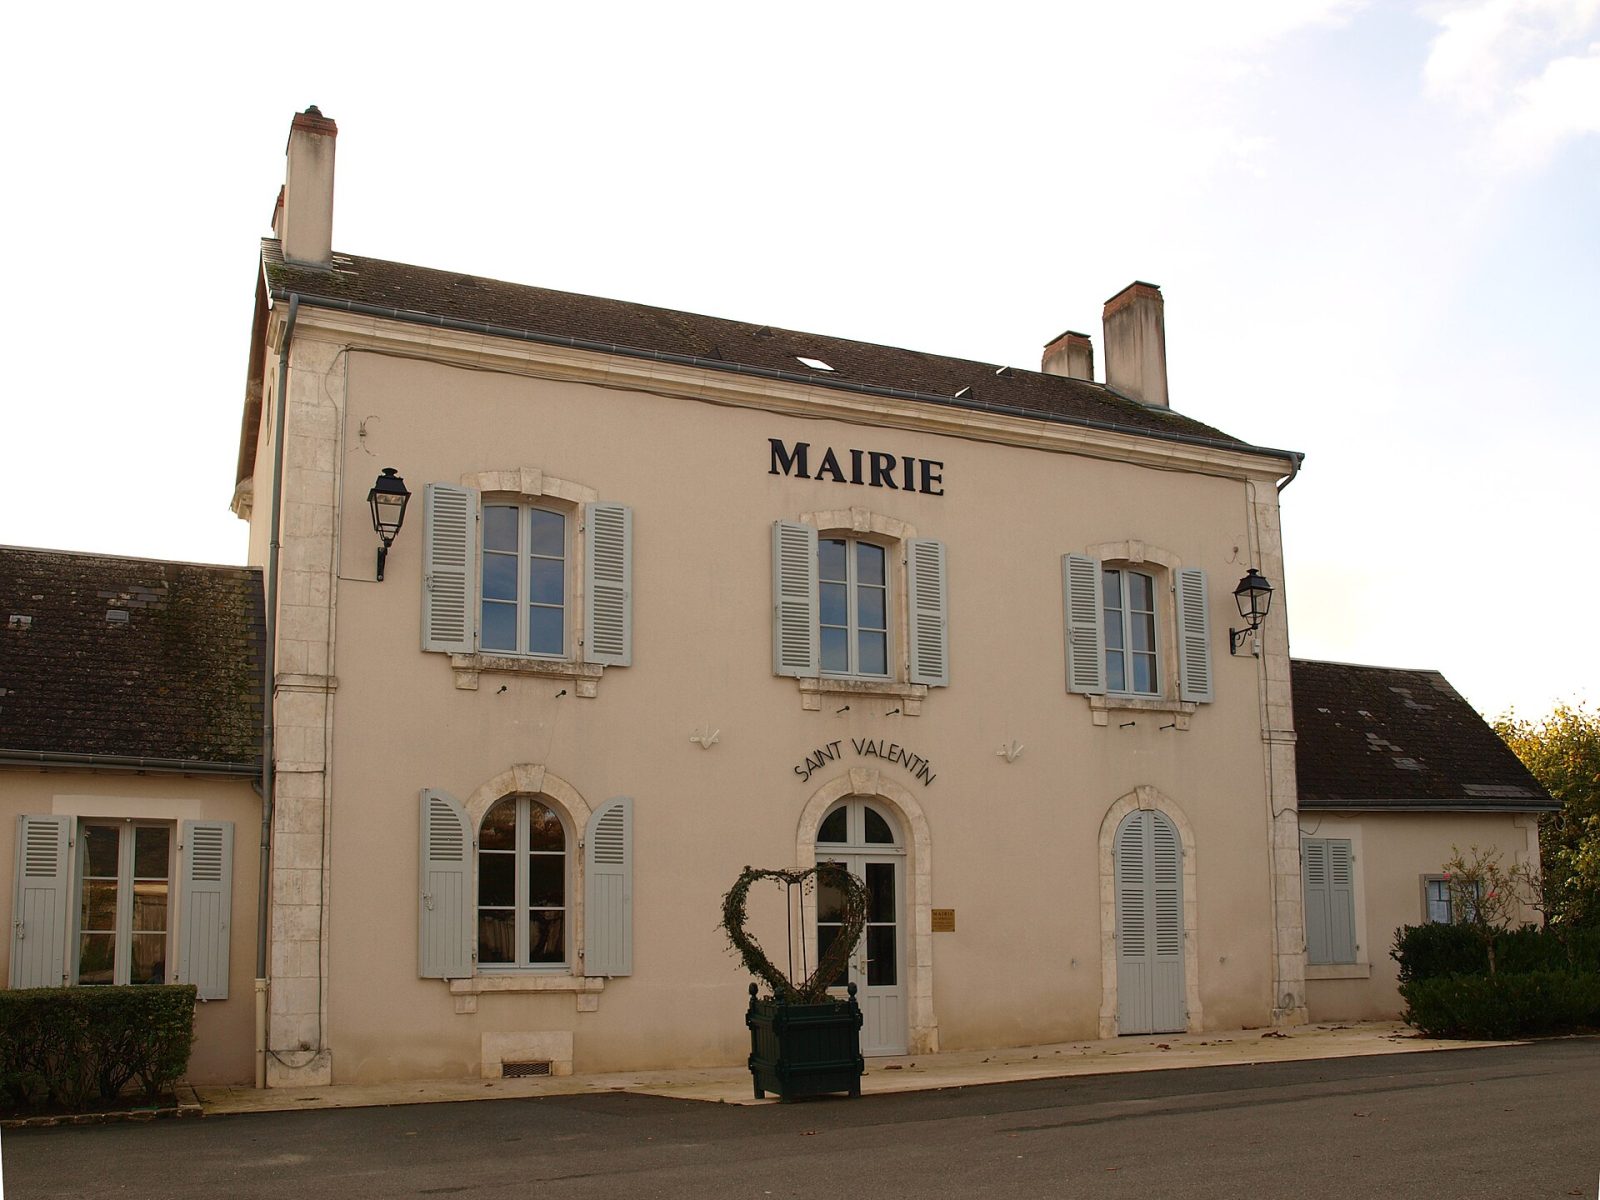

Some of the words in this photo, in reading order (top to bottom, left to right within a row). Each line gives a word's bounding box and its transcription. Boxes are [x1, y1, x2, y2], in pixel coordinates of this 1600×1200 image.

[768, 438, 944, 496] MAIRIE
[794, 740, 842, 783] SAINT
[851, 738, 936, 787] VALENTIN
